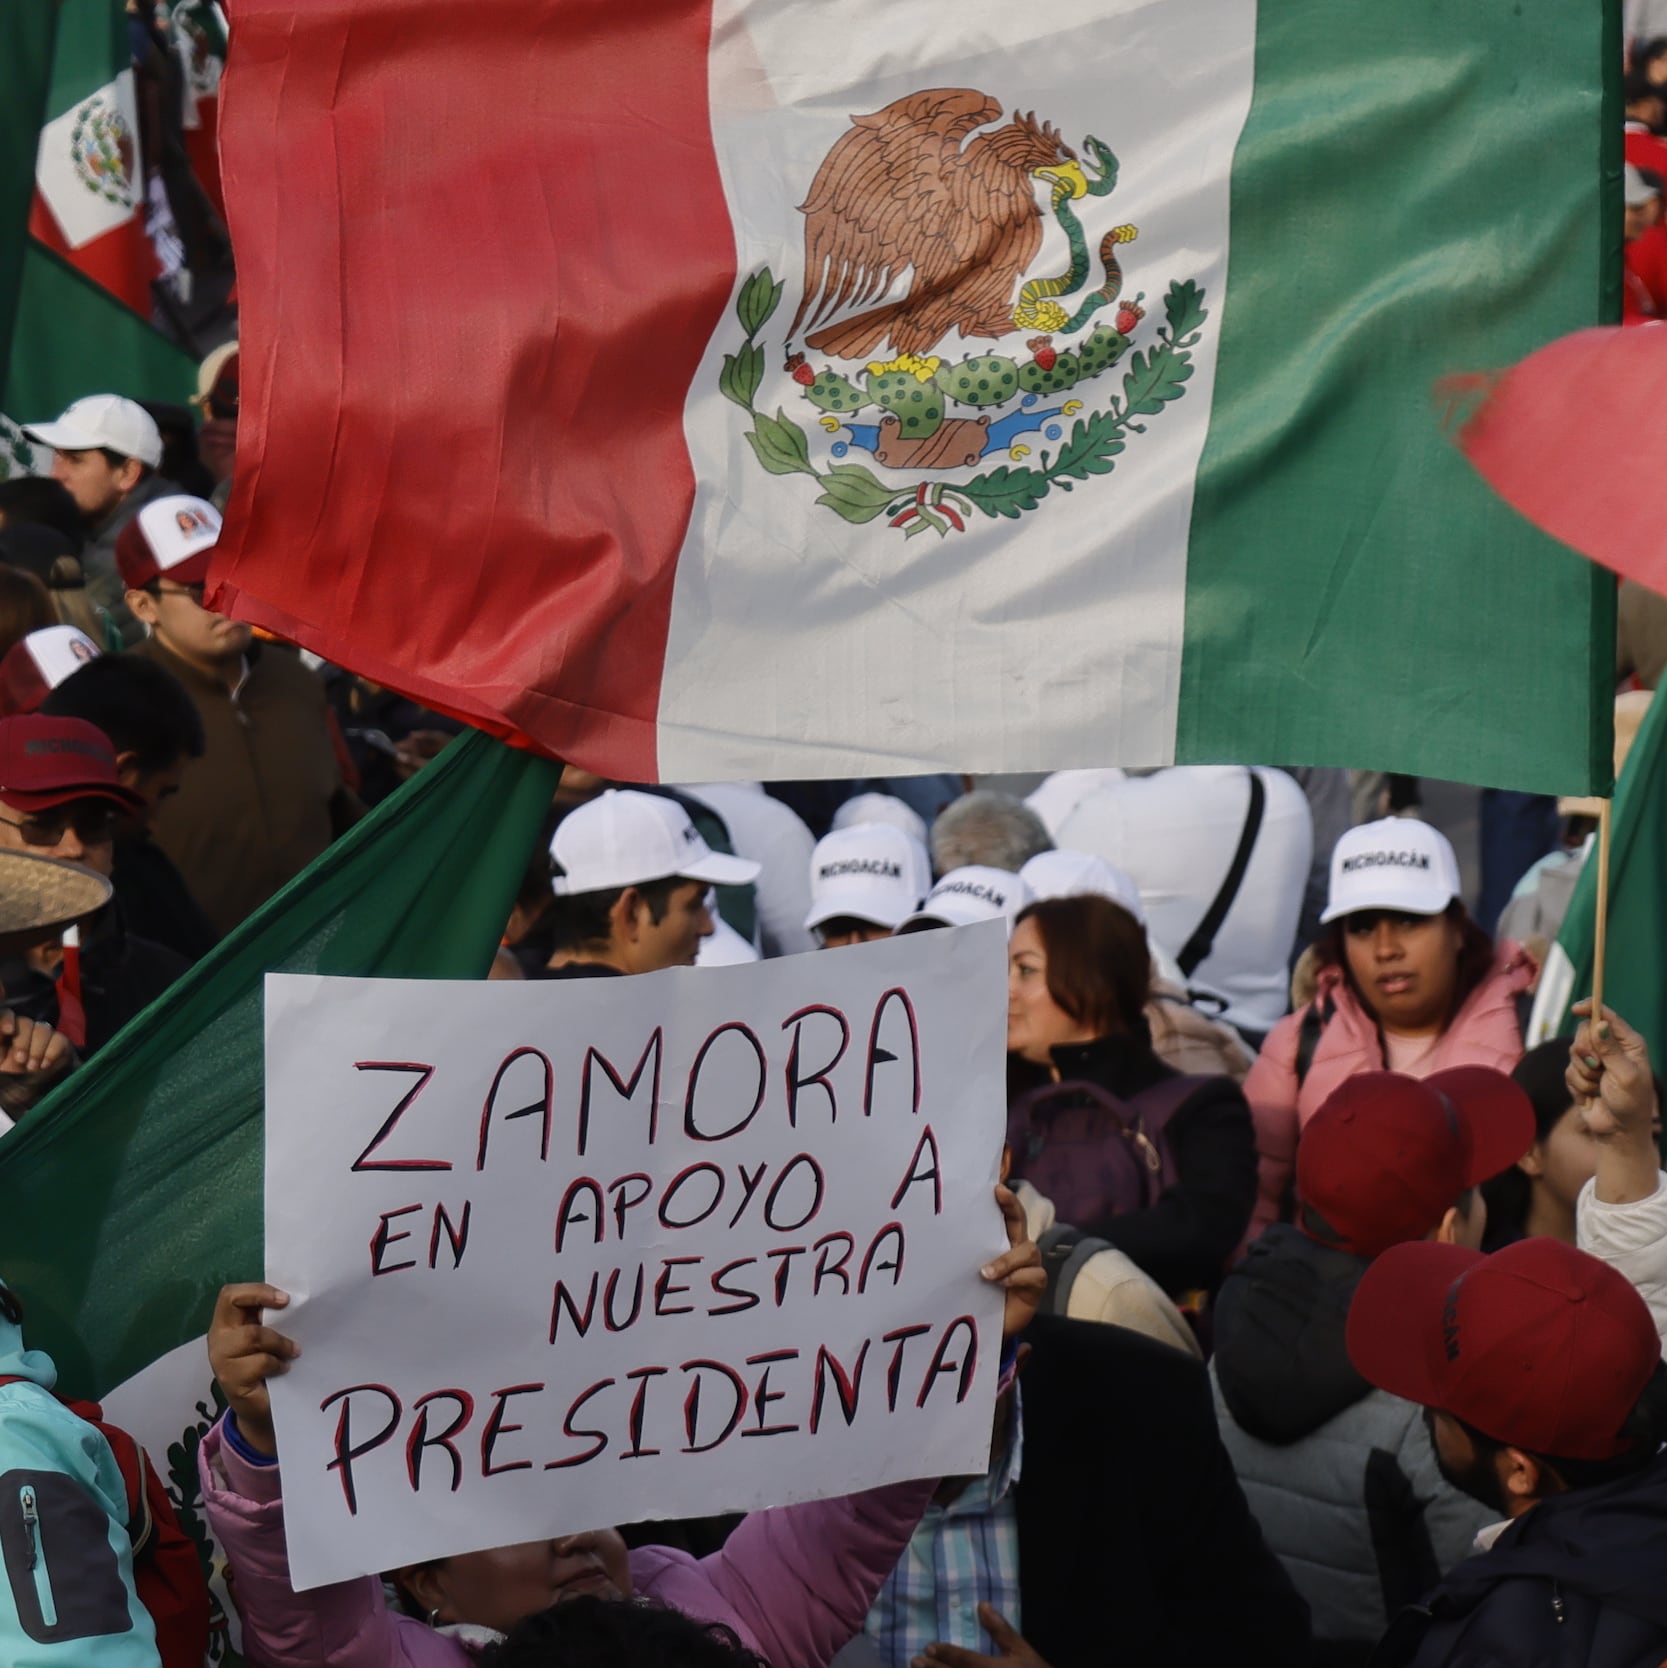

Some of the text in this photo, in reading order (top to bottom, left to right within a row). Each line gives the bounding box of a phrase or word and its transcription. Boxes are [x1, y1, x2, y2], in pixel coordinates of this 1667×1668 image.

[351, 986, 921, 1172] ZAMORA
[370, 1123, 942, 1277] EN APOYO A
[548, 1221, 905, 1345] NUESTRA
[319, 1314, 979, 1516] PRESIDENTA
